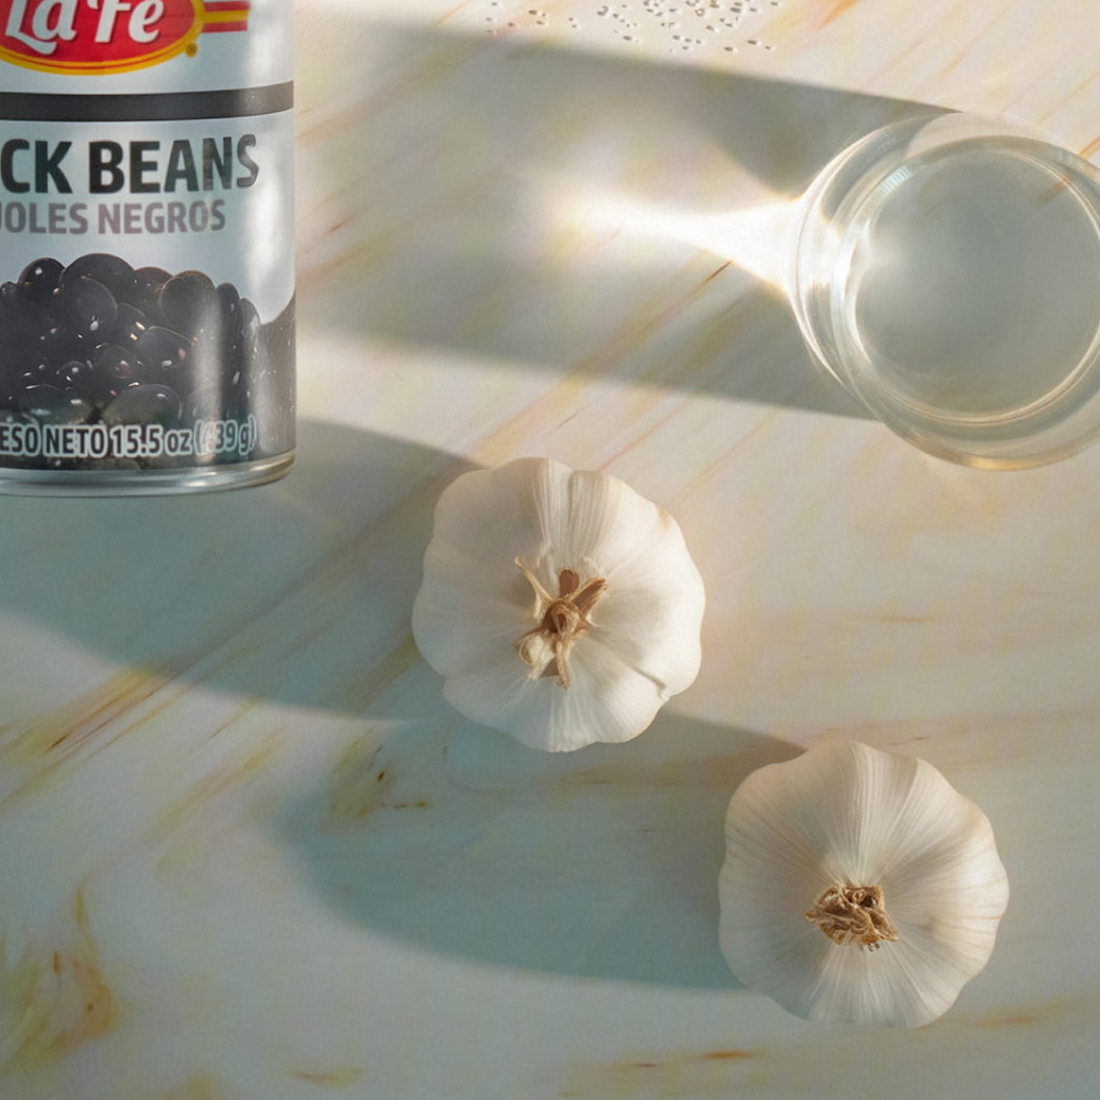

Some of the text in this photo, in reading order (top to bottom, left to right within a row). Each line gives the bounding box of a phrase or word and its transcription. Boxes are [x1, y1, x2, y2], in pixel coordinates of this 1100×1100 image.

[88, 133, 260, 195] BEANS
[99, 198, 227, 235] NEGROS
[43, 423, 108, 458] NETO
[109, 424, 164, 458] 15.5
[165, 429, 192, 455] oz
[193, 418, 237, 456] (39
